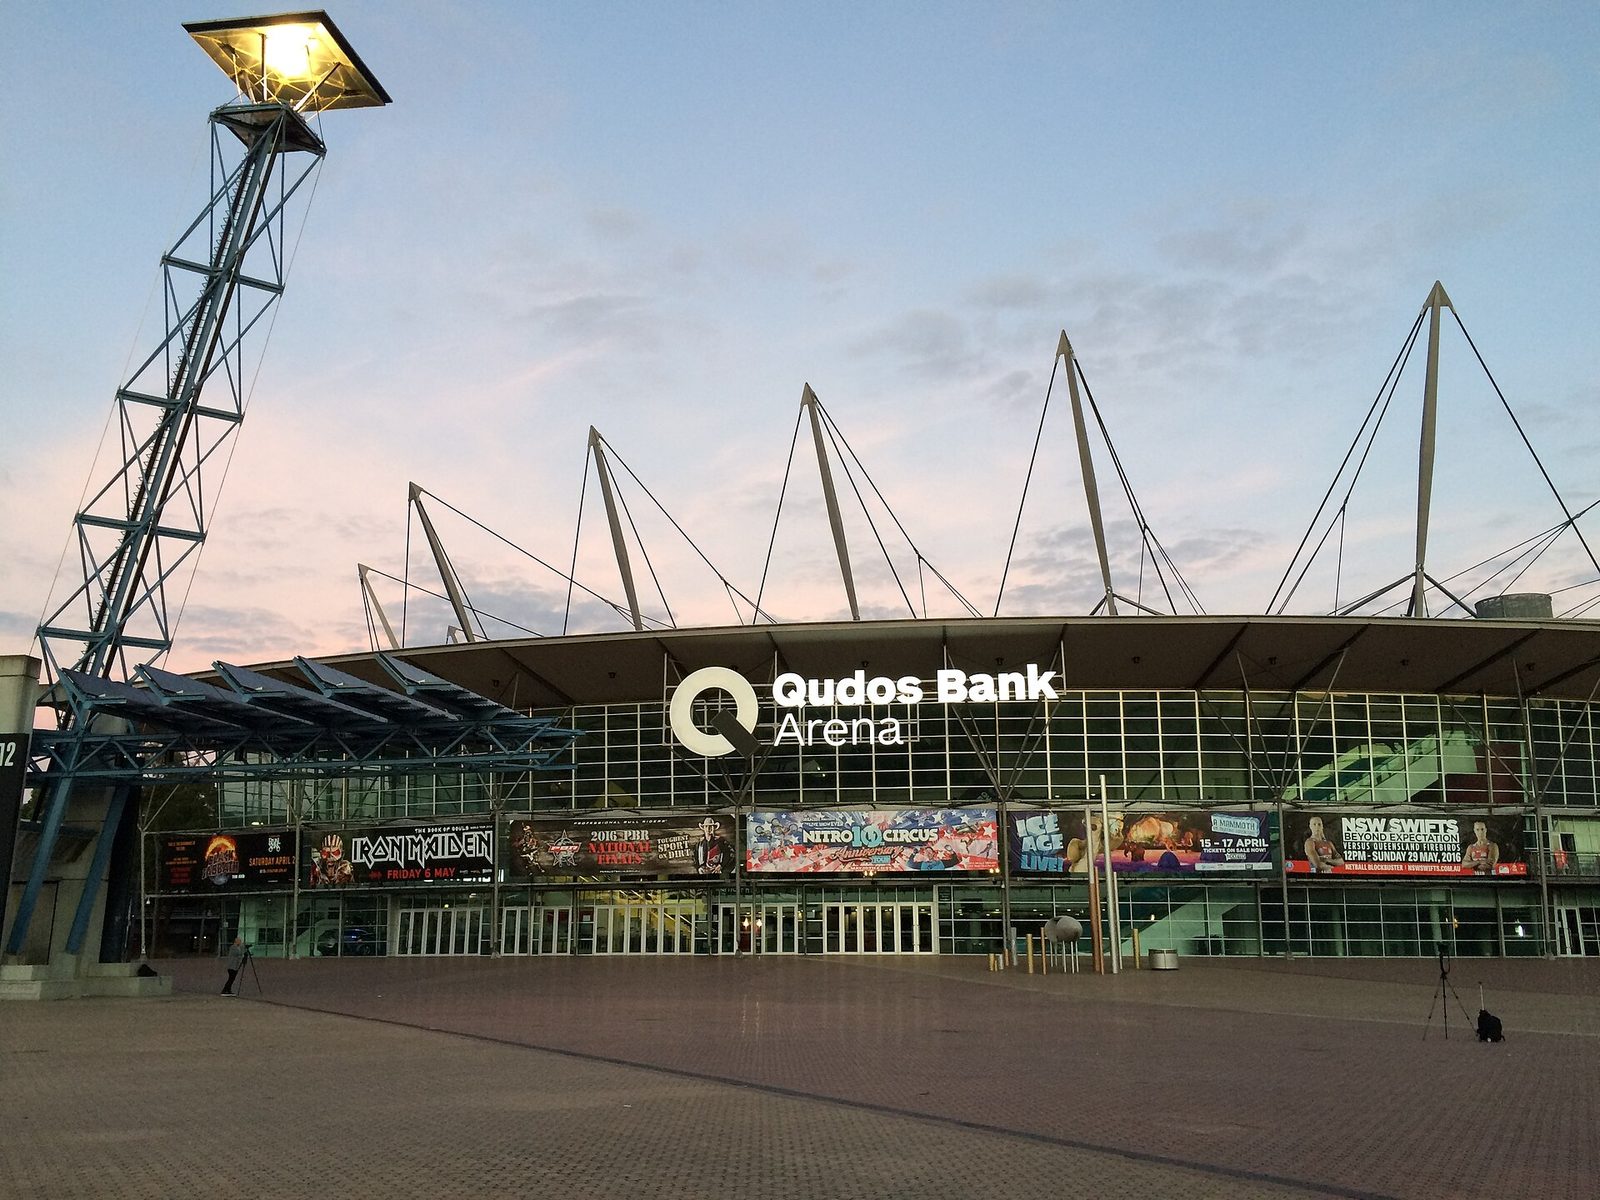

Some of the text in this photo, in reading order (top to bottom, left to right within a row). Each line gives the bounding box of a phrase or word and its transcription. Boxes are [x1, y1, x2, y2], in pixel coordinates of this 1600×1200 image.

[772, 663, 1059, 708] Qudos Bank
[774, 712, 904, 748] Arena
[1016, 814, 1060, 838] ICE
[1219, 819, 1255, 831] MAMMOTH
[1342, 817, 1459, 834] NSW SWIFTS
[590, 829, 650, 841] 2016 PBR
[657, 834, 689, 844] TOUGHEST
[802, 829, 853, 843] NITRO
[882, 828, 939, 843] CIRCUS
[1344, 832, 1458, 843] BEYOND EXPECTATION
[587, 840, 653, 853] NATIONAL
[657, 841, 689, 853] SPORT
[1021, 833, 1064, 852] AGE
[1199, 838, 1212, 848] 15
[1221, 838, 1234, 848] 17
[1236, 838, 1269, 847] APRIL
[1342, 842, 1461, 851] VERSUS QUEENSLAND FIREBIRDS
[351, 830, 493, 869] IRON MAIDEN
[668, 848, 691, 859] DIRT
[834, 845, 904, 860] Anniversary
[249, 857, 275, 866] SATURDAY
[275, 856, 291, 865] APRIL
[596, 853, 643, 865] FINALS
[1343, 850, 1367, 861] 12PM
[1372, 851, 1407, 862] SUNDAY
[1408, 851, 1419, 862] 29
[1419, 852, 1441, 863] MAY,
[1441, 852, 1461, 862] 2016
[1020, 854, 1064, 872] LIVE!
[387, 869, 422, 879] FRIDAY
[424, 868, 431, 878] 6
[434, 867, 456, 877] MAY
